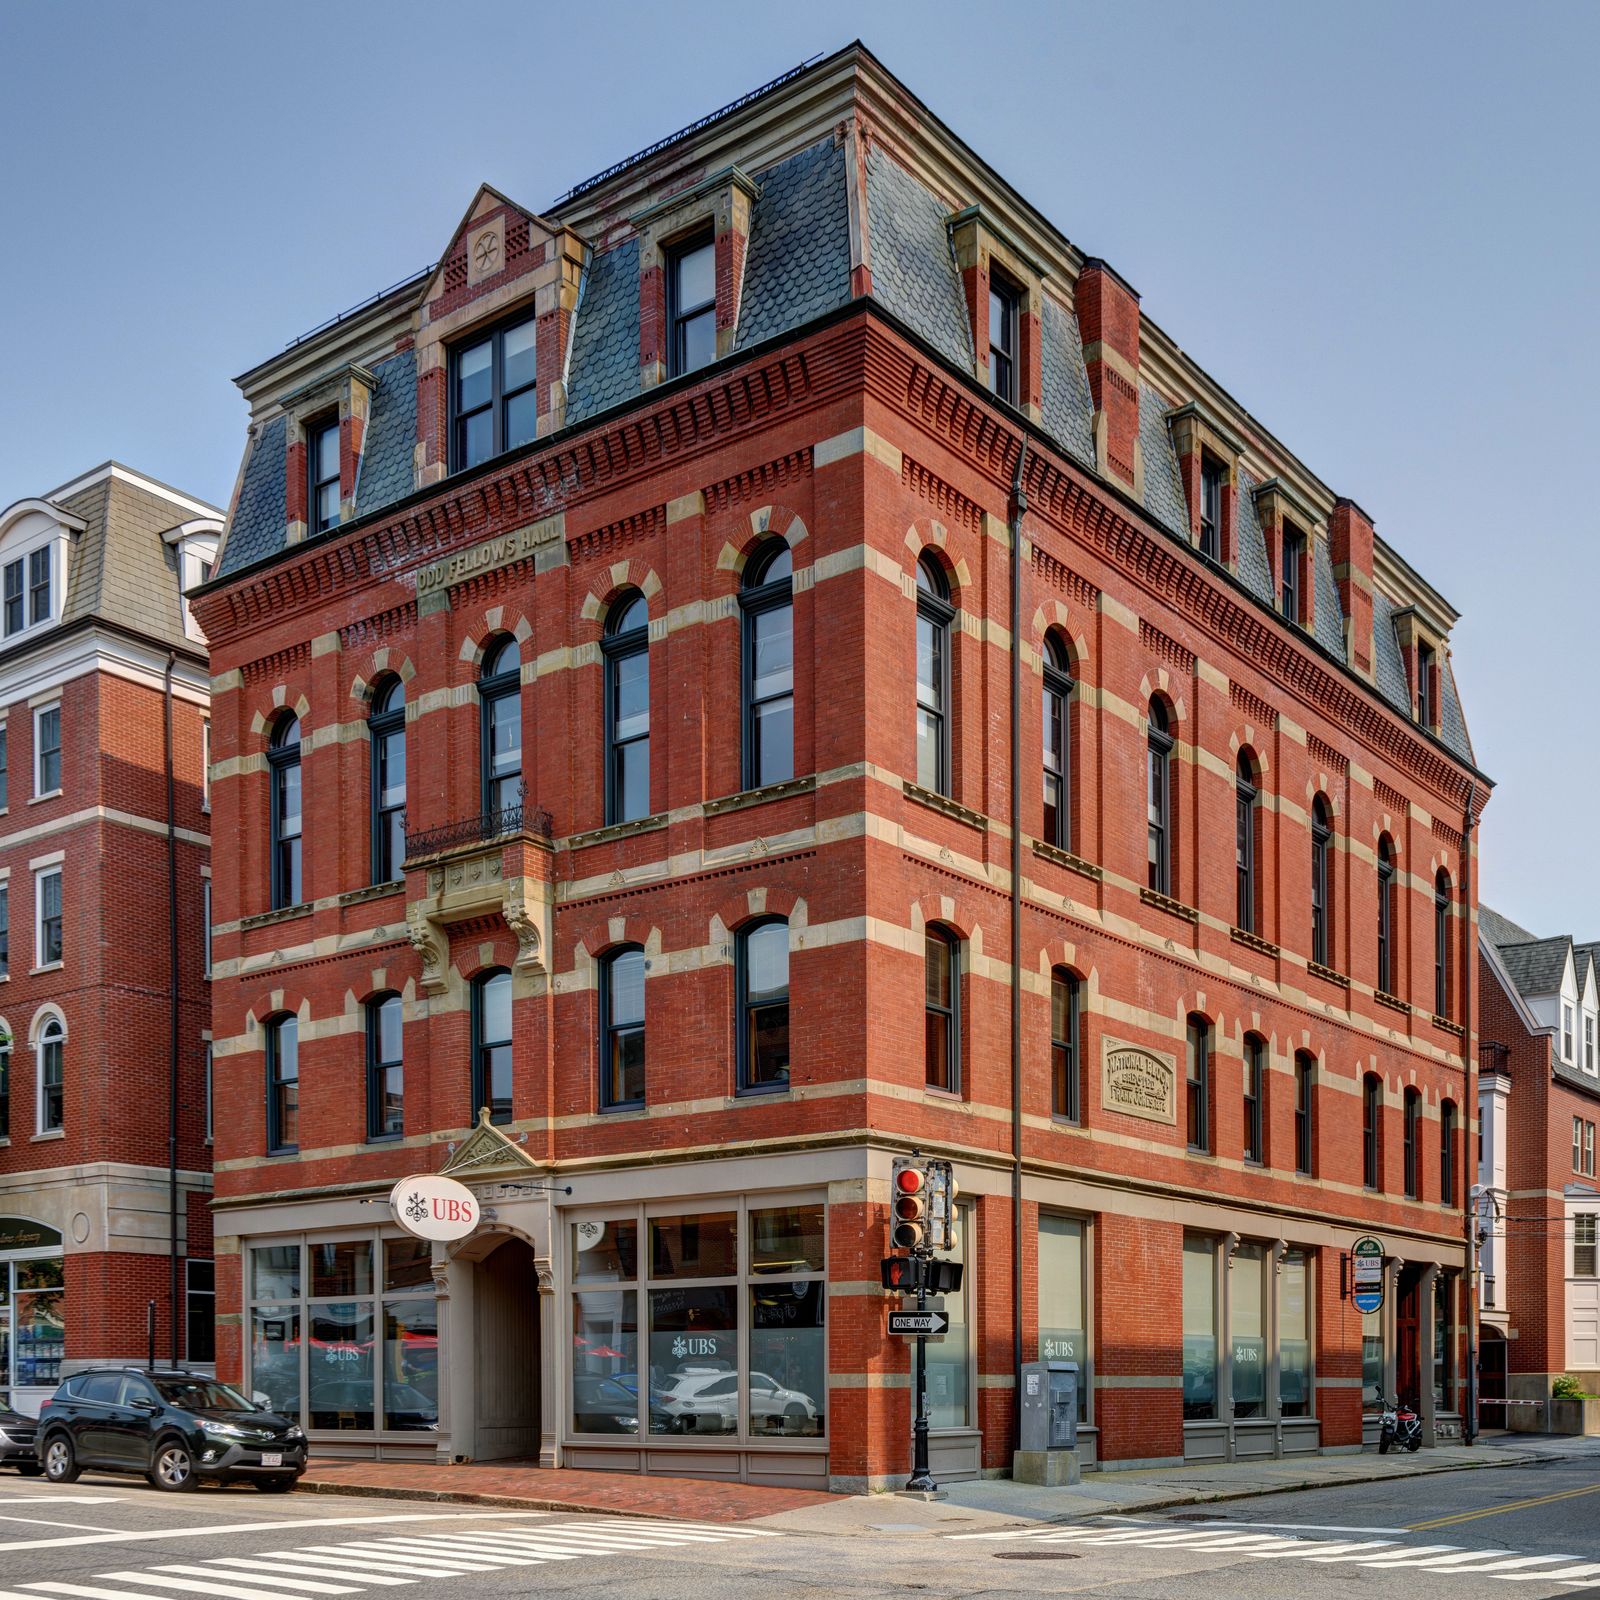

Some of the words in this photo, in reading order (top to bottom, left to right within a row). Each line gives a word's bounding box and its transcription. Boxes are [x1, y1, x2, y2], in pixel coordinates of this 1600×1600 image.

[418, 564, 444, 590] ODD
[448, 538, 516, 579] FELLOWS
[521, 521, 560, 552] HALL
[1107, 1054, 1143, 1083] NATIONAL
[1145, 1059, 1169, 1096] BLOCK
[432, 1197, 472, 1223] UBS
[1365, 1259, 1379, 1268] UBS
[894, 1318, 911, 1328] ONE
[914, 1318, 931, 1328] WAY
[337, 1347, 360, 1362] UBS
[688, 1338, 717, 1355] UBS
[1055, 1341, 1074, 1357] UBS
[1243, 1349, 1258, 1362] UBS
